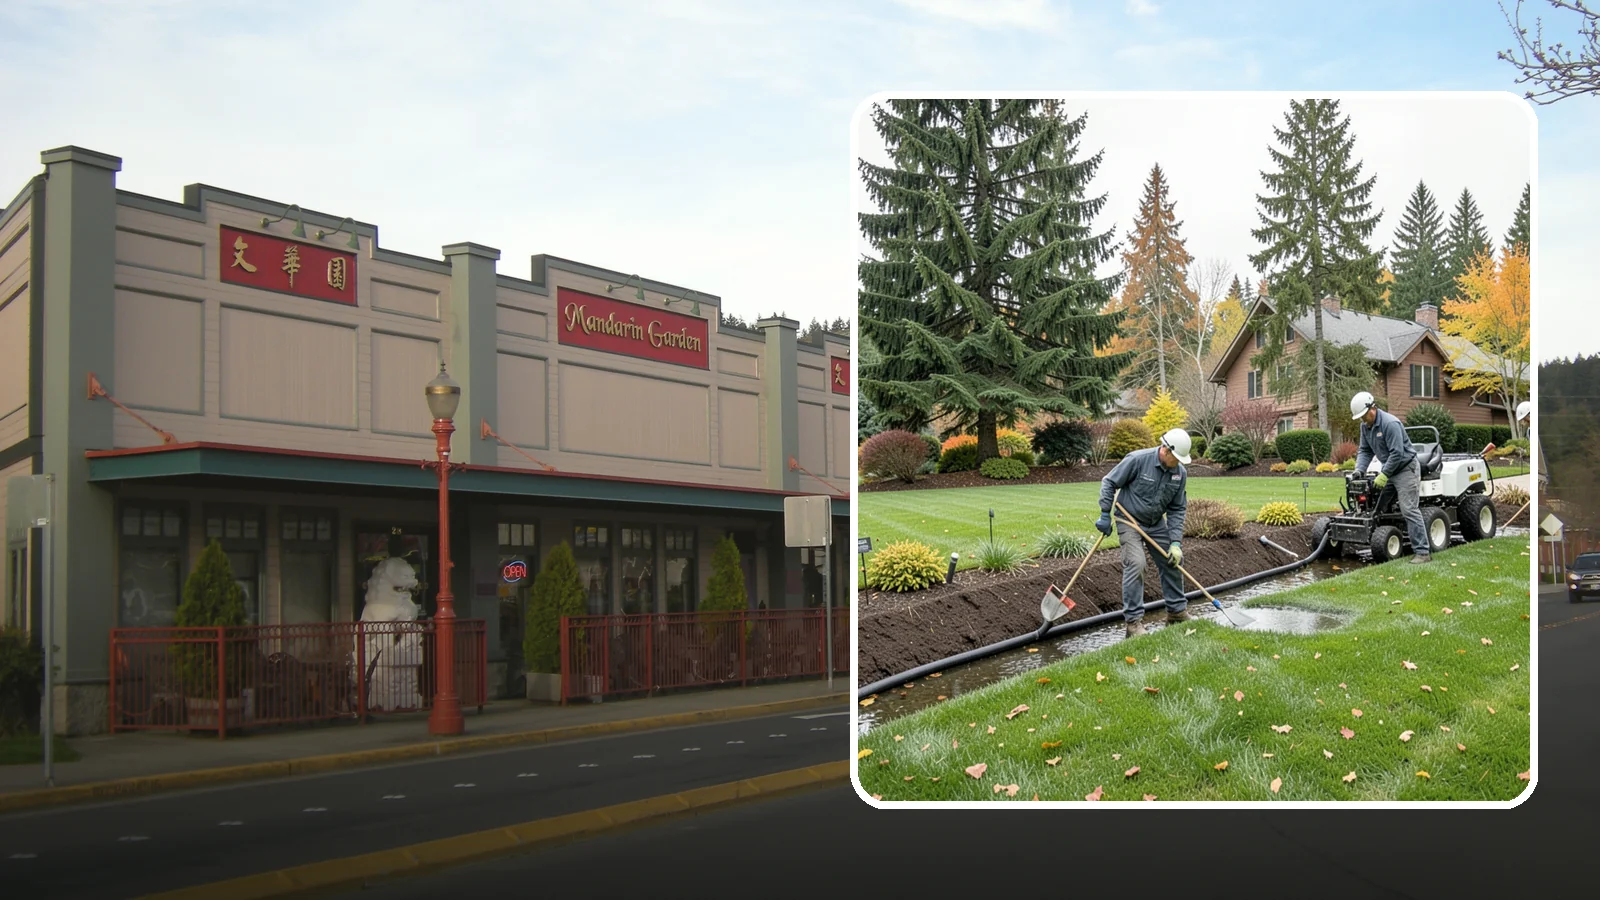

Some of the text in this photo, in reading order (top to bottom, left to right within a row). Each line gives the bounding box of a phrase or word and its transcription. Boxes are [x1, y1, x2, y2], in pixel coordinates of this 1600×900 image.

[230, 235, 346, 291] 文華園
[564, 302, 701, 352] Mandarin Garden
[503, 565, 527, 578] OPEN
